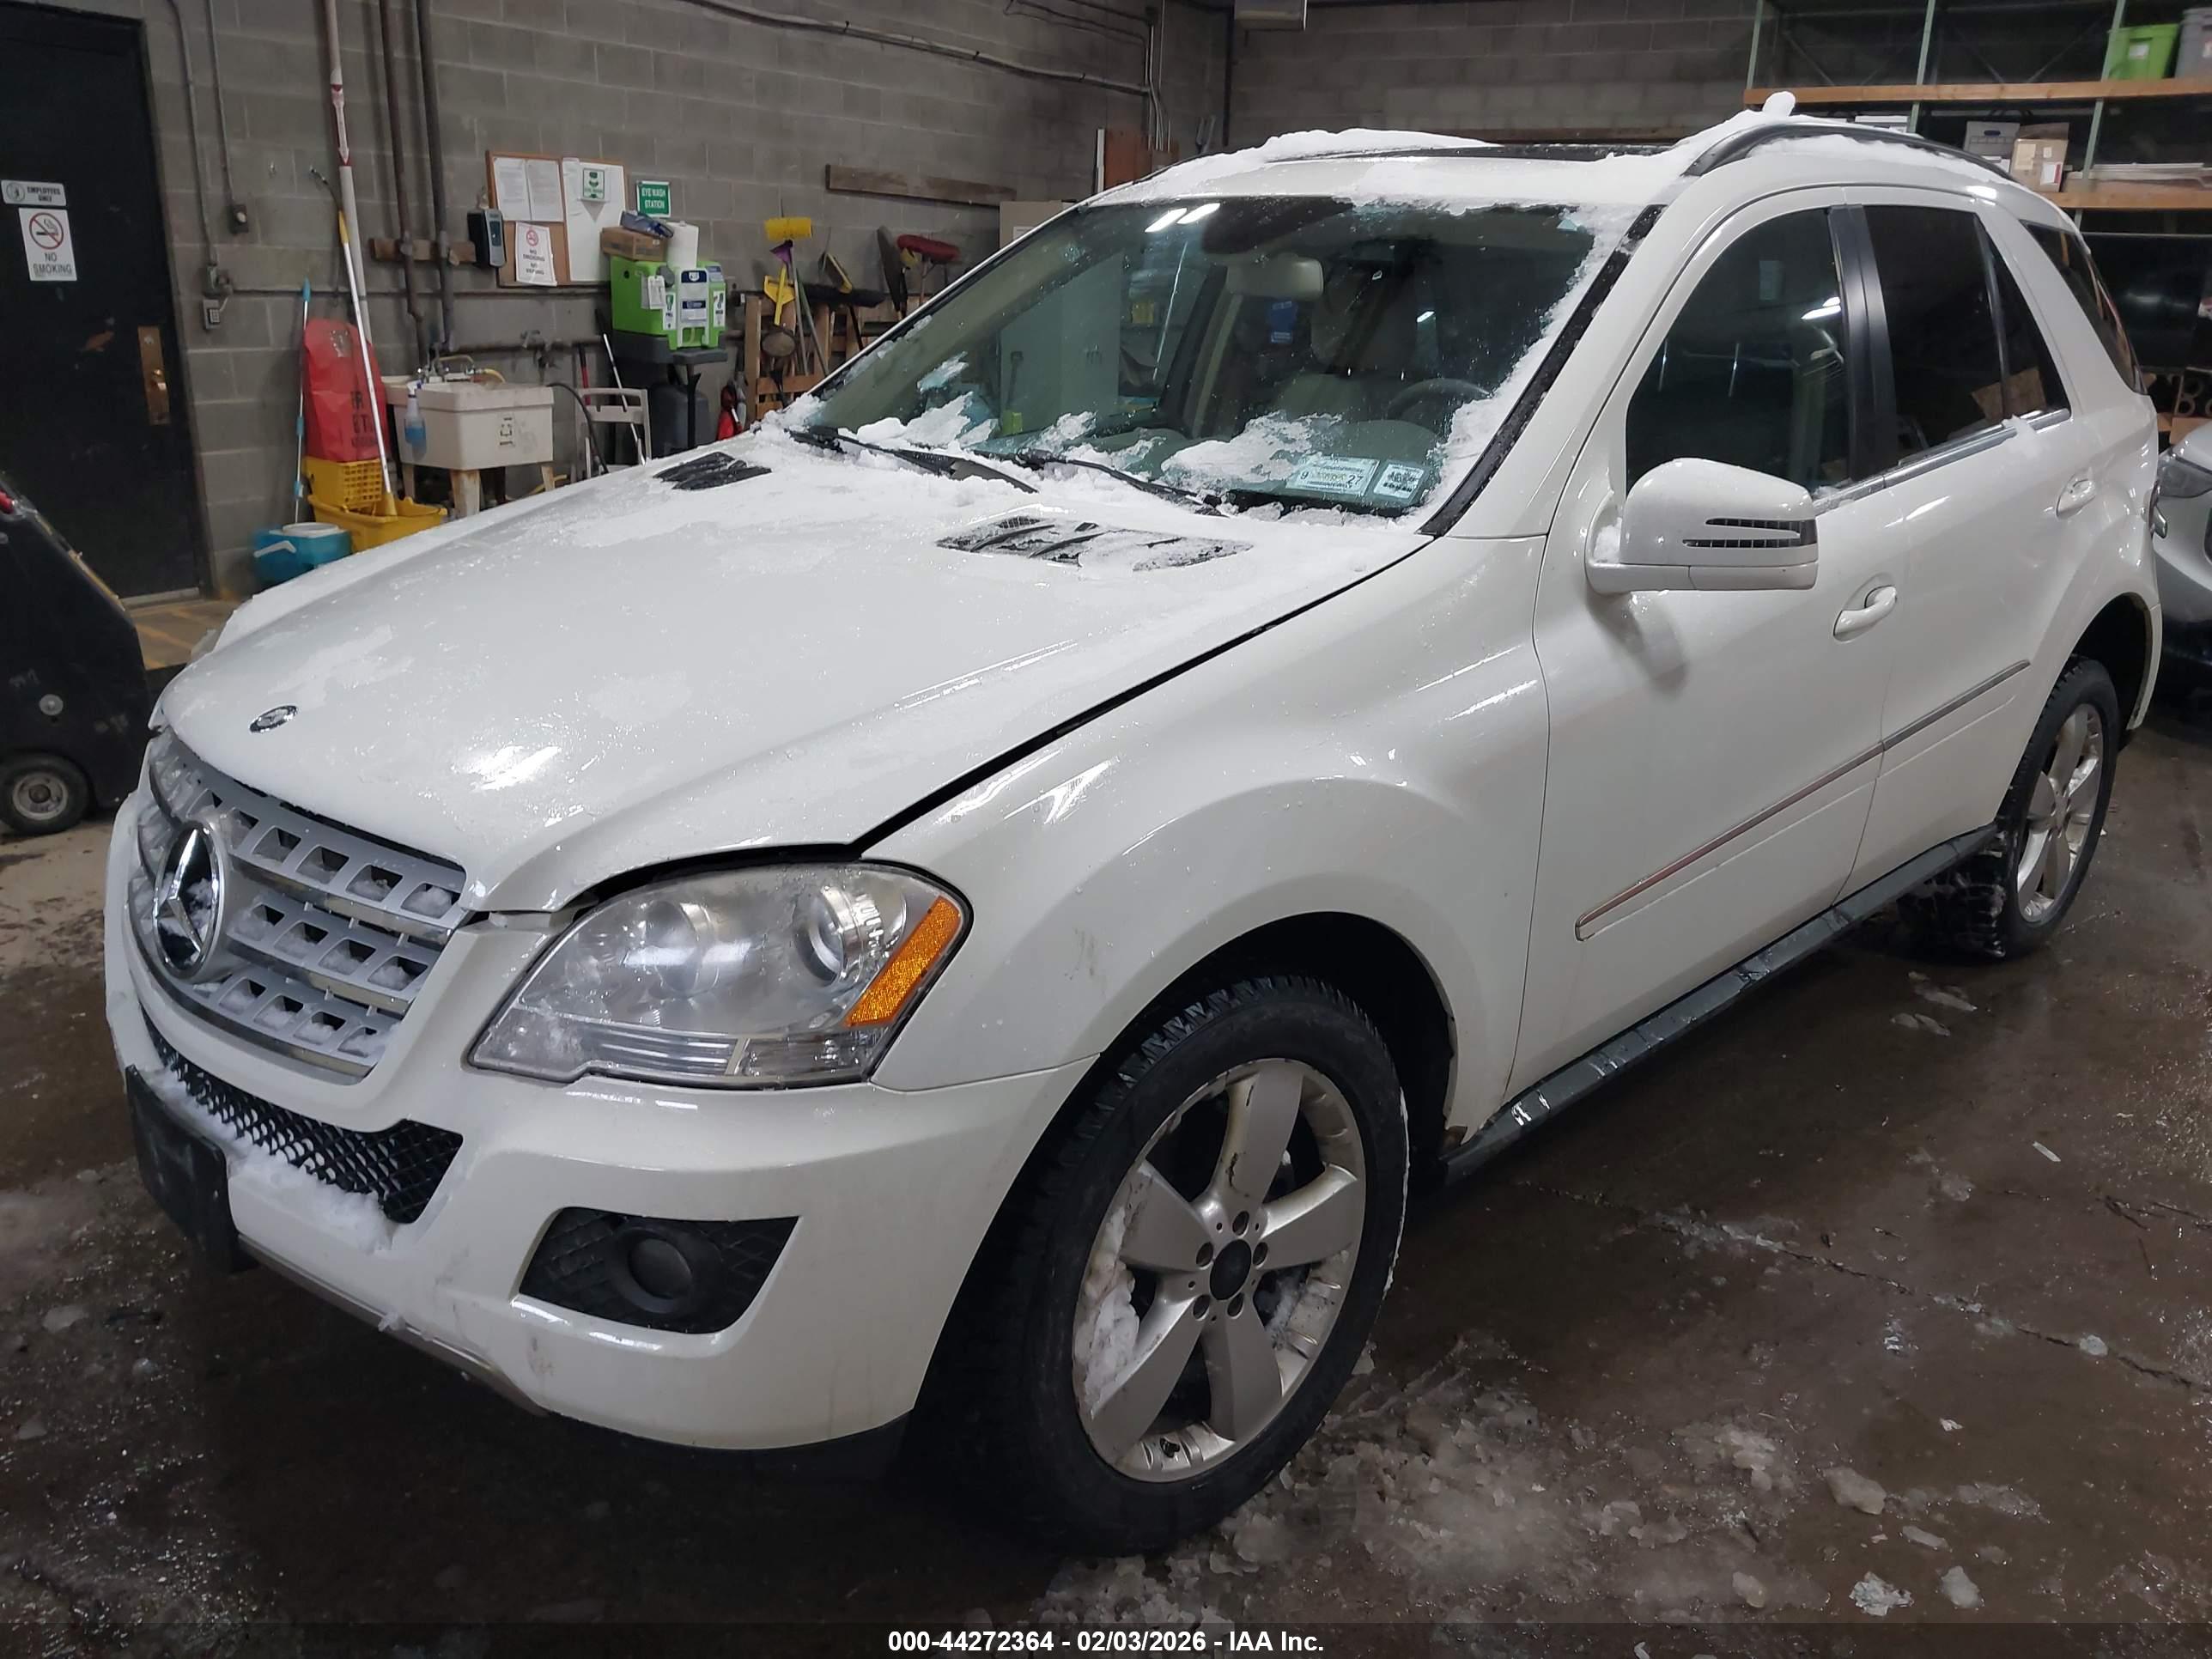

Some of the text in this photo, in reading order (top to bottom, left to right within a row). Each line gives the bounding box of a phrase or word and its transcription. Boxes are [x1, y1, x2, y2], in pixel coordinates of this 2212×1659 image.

[641, 187, 666, 198] EYE WASH
[645, 199, 665, 209] STATION
[44, 252, 58, 261] NO
[33, 263, 72, 275] SMOKING
[1300, 471, 1310, 480] 9
[1346, 473, 1364, 486] 27
